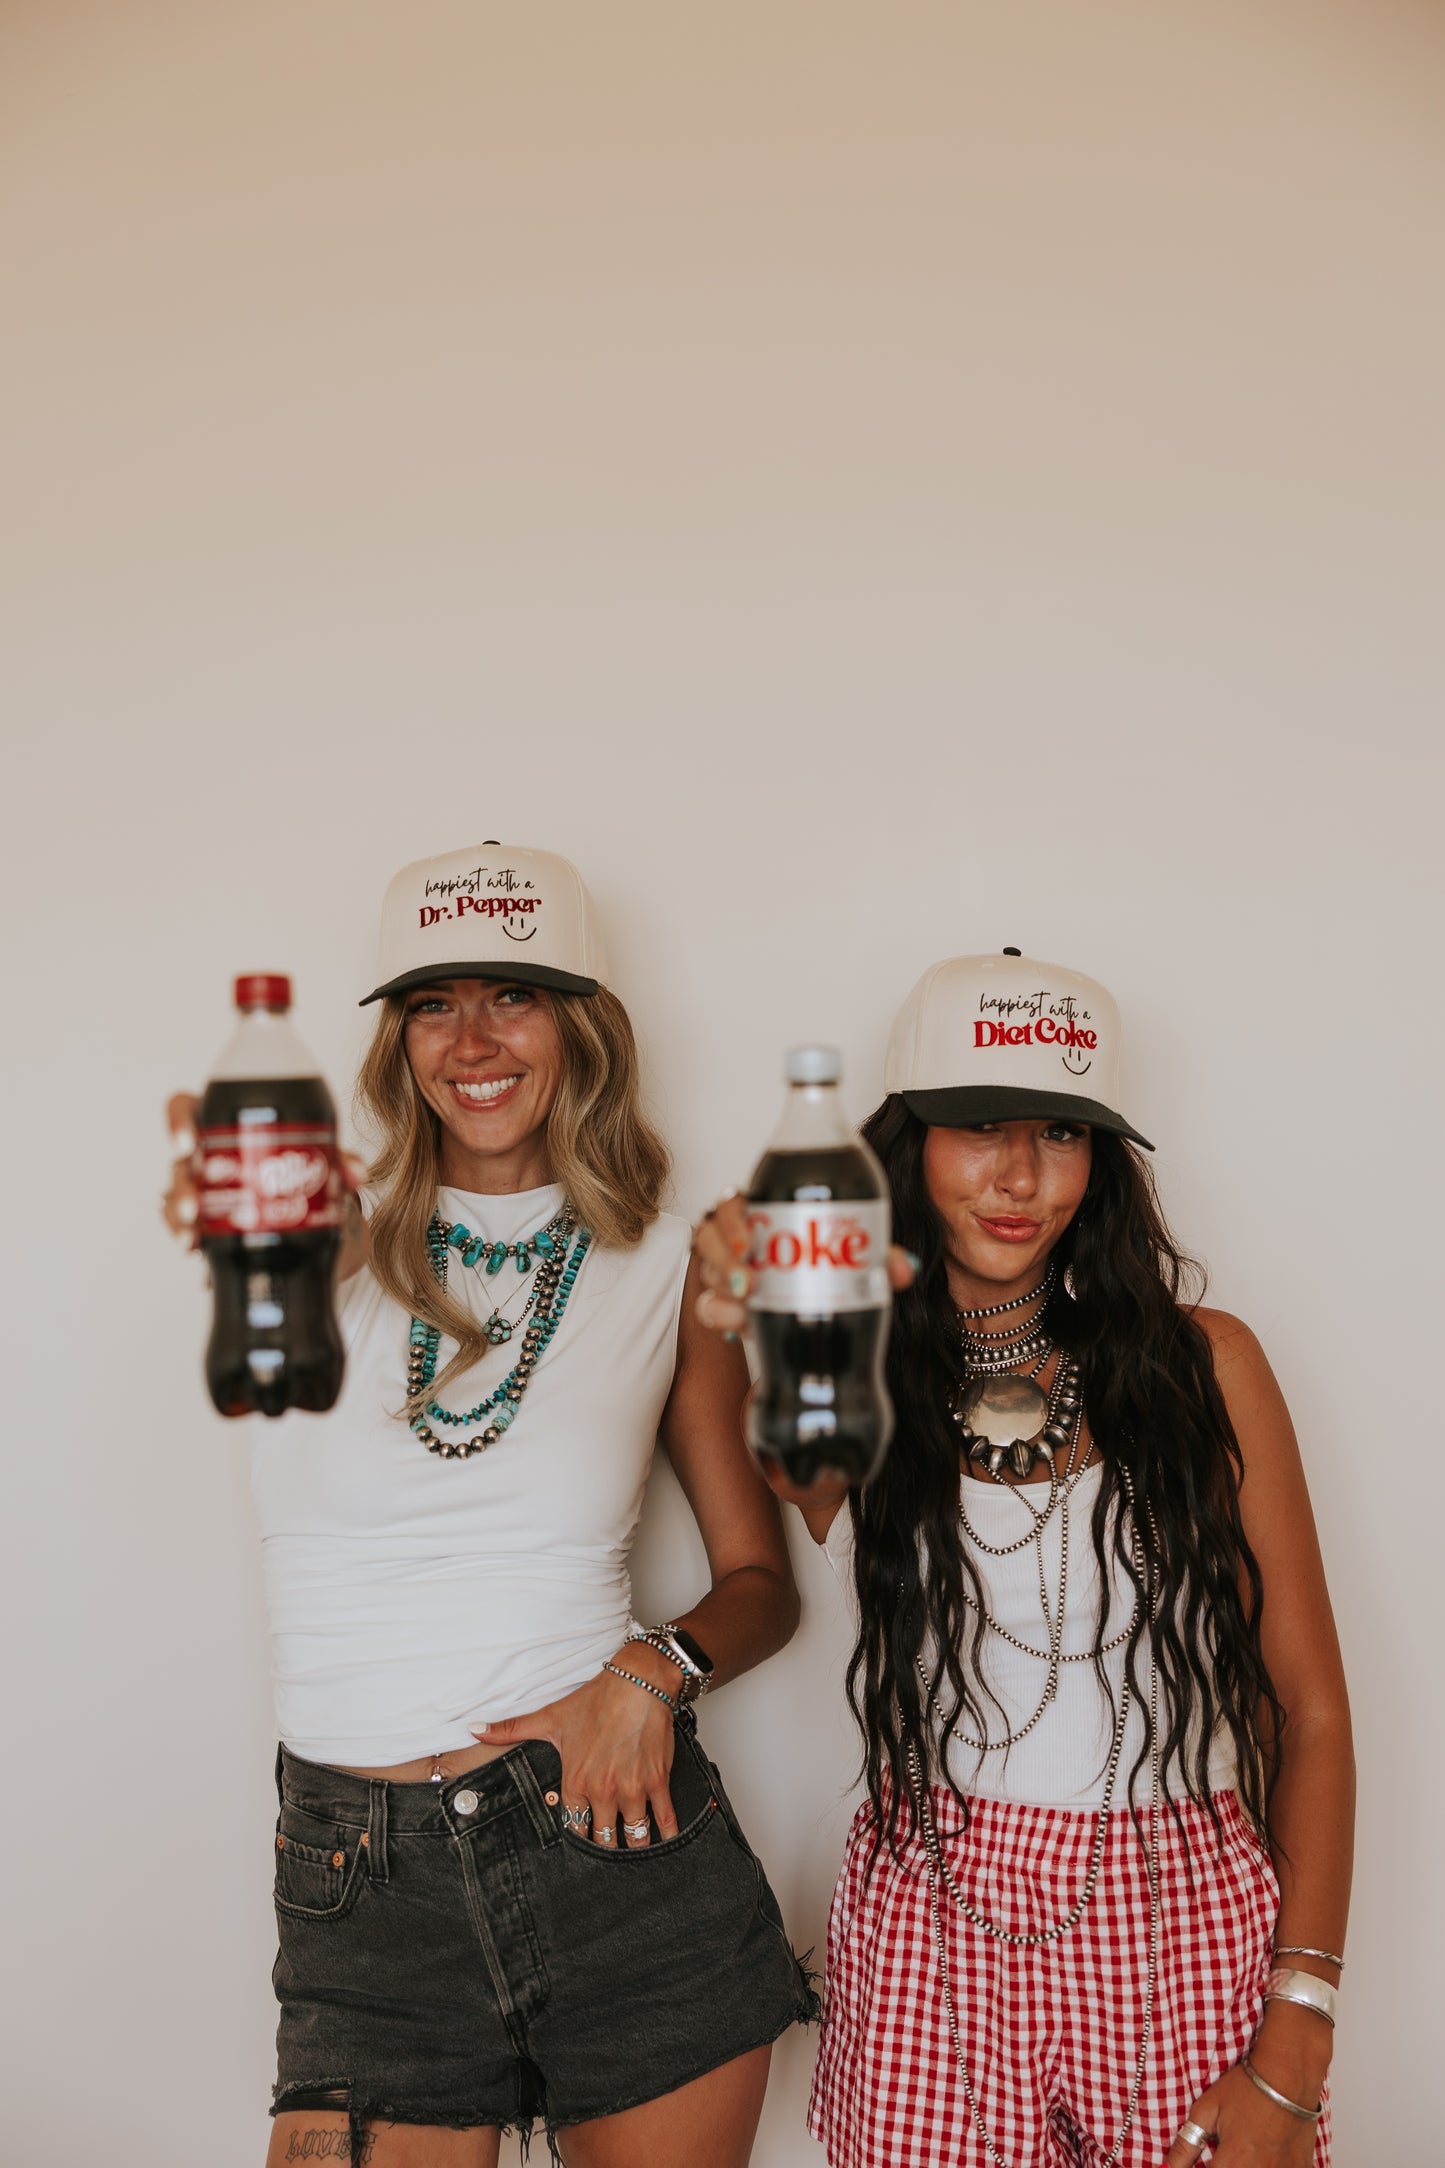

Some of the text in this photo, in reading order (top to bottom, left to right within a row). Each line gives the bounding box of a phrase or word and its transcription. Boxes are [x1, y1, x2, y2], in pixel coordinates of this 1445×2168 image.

[425, 867, 535, 898] happiest with a
[419, 896, 542, 928] Dr. Pepper
[980, 991, 1091, 1022] happiest with a
